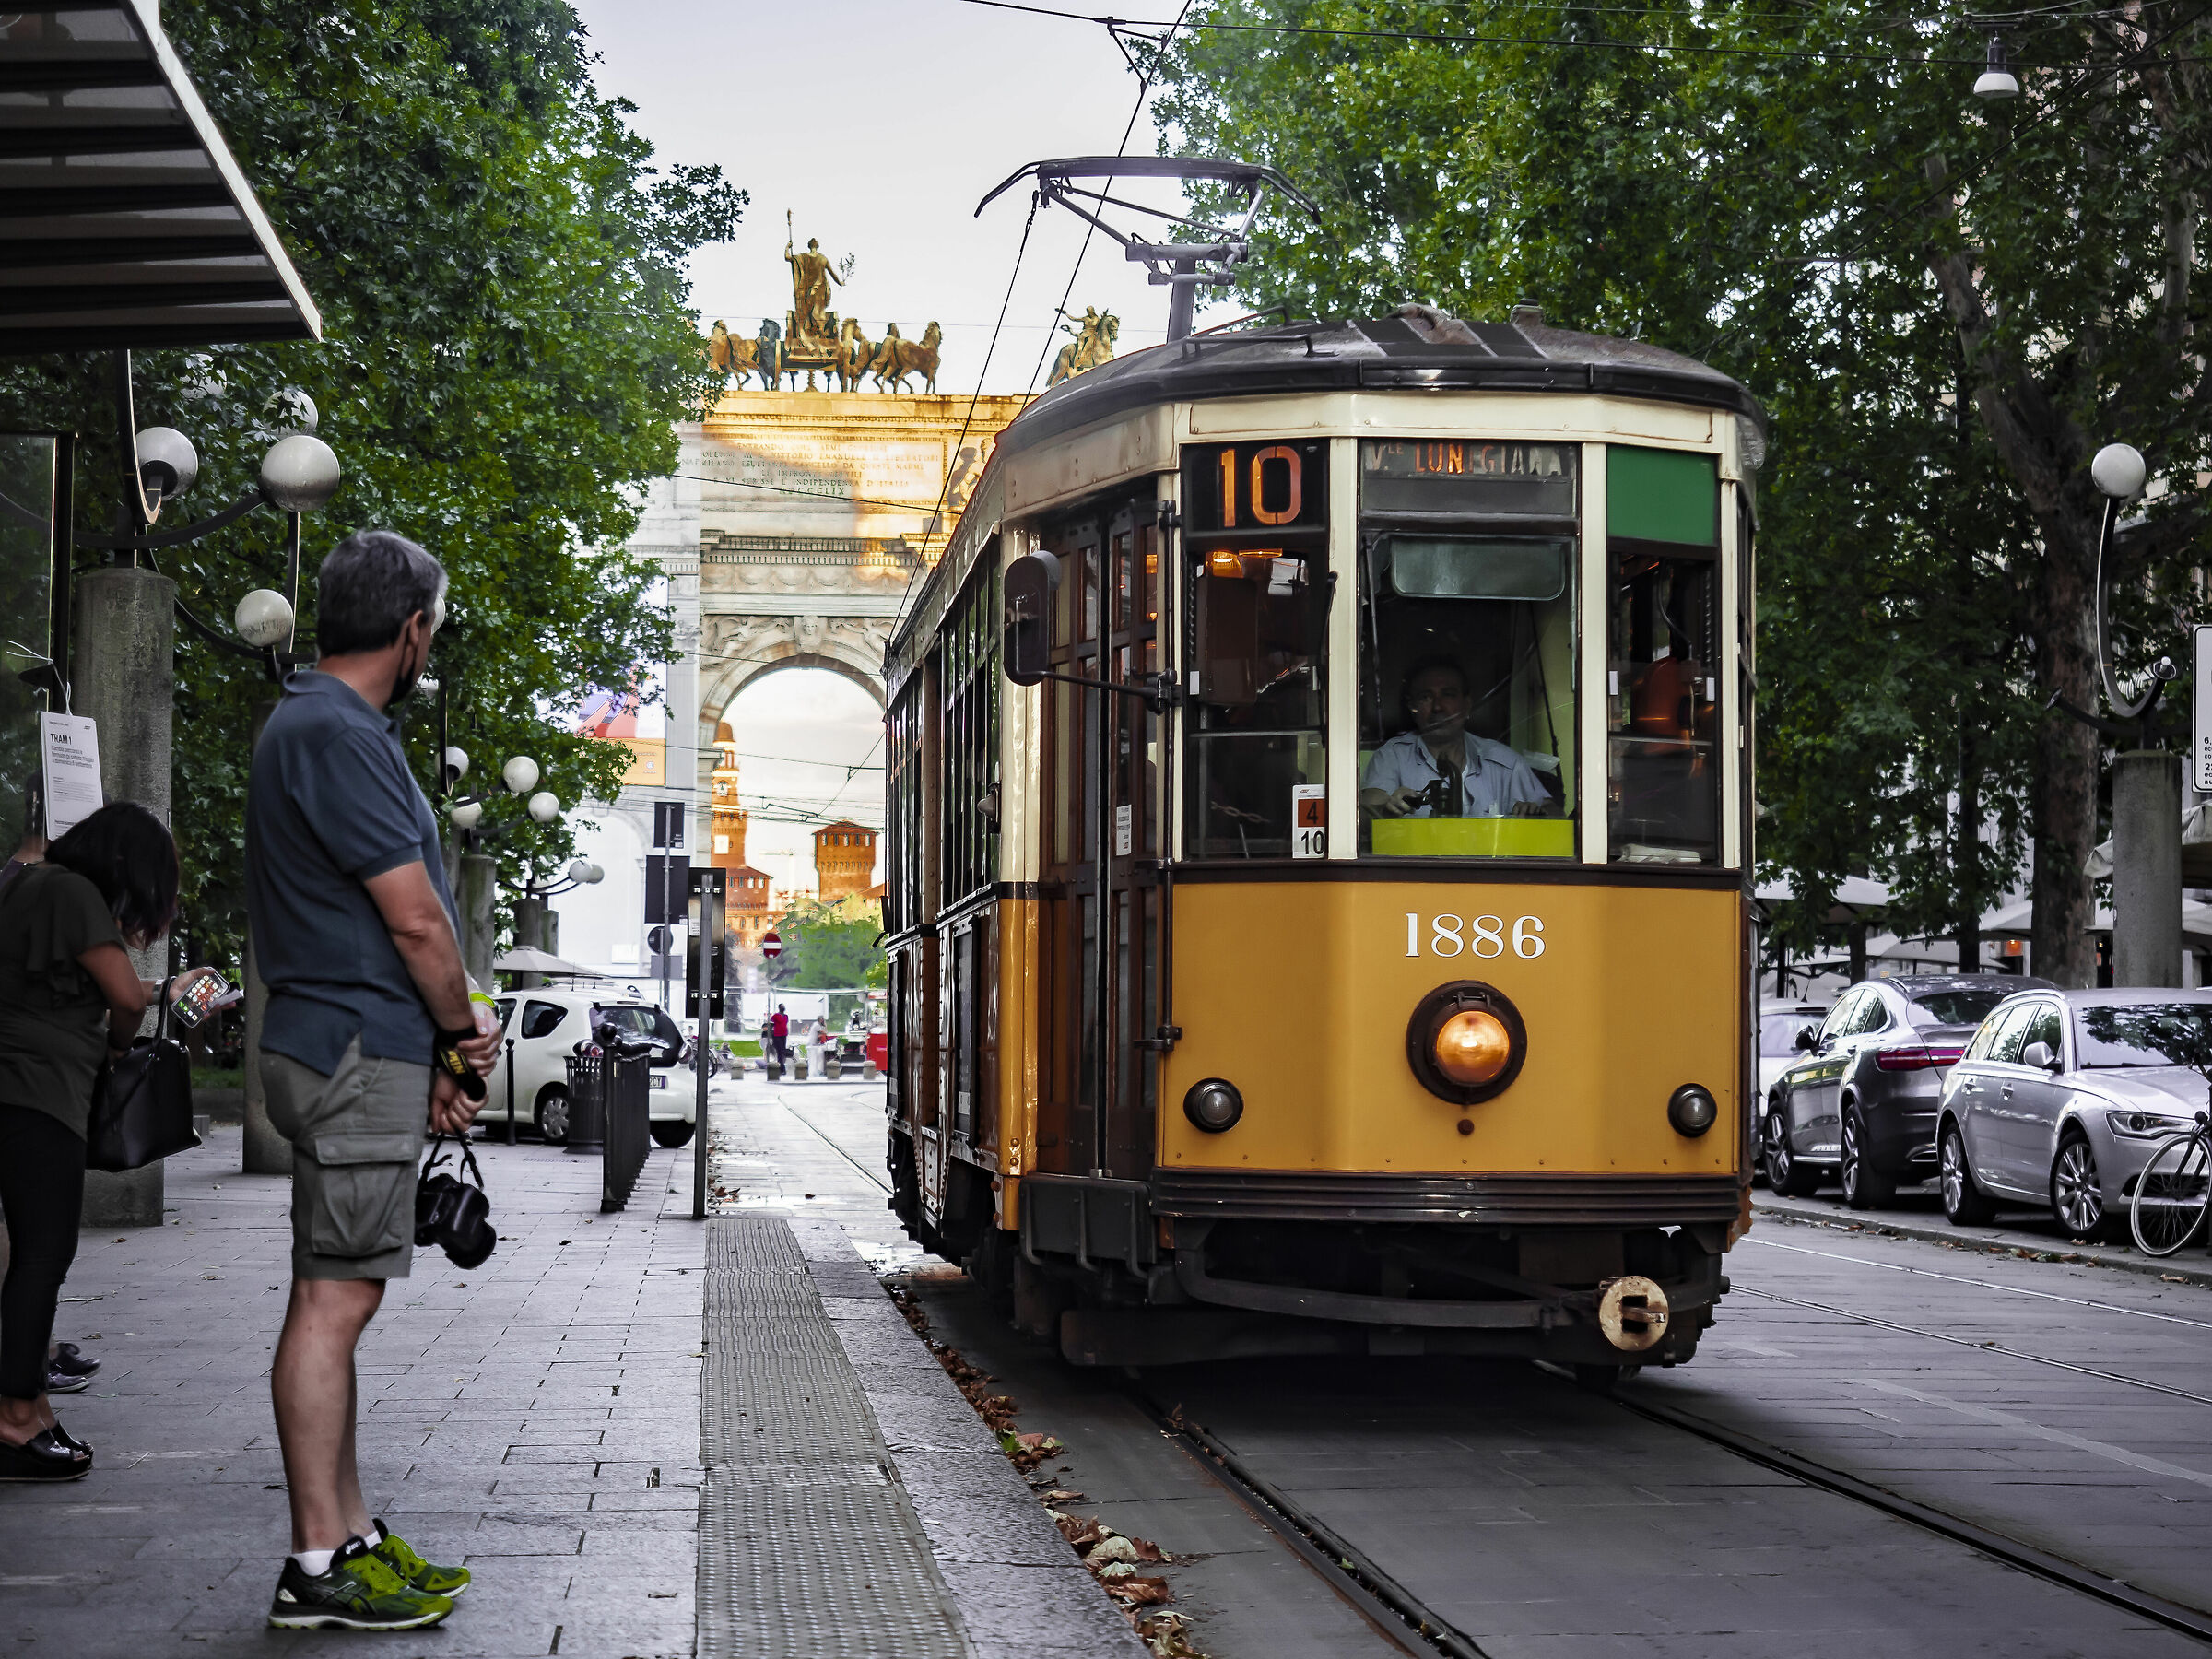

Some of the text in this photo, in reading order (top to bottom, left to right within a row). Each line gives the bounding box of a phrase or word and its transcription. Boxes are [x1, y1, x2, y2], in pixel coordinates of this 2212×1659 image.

[1220, 446, 1302, 527] 10
[50, 734, 67, 744] TRAM
[1306, 801, 1319, 825] 4
[1300, 830, 1325, 855] 10
[1406, 912, 1547, 959] 1886
